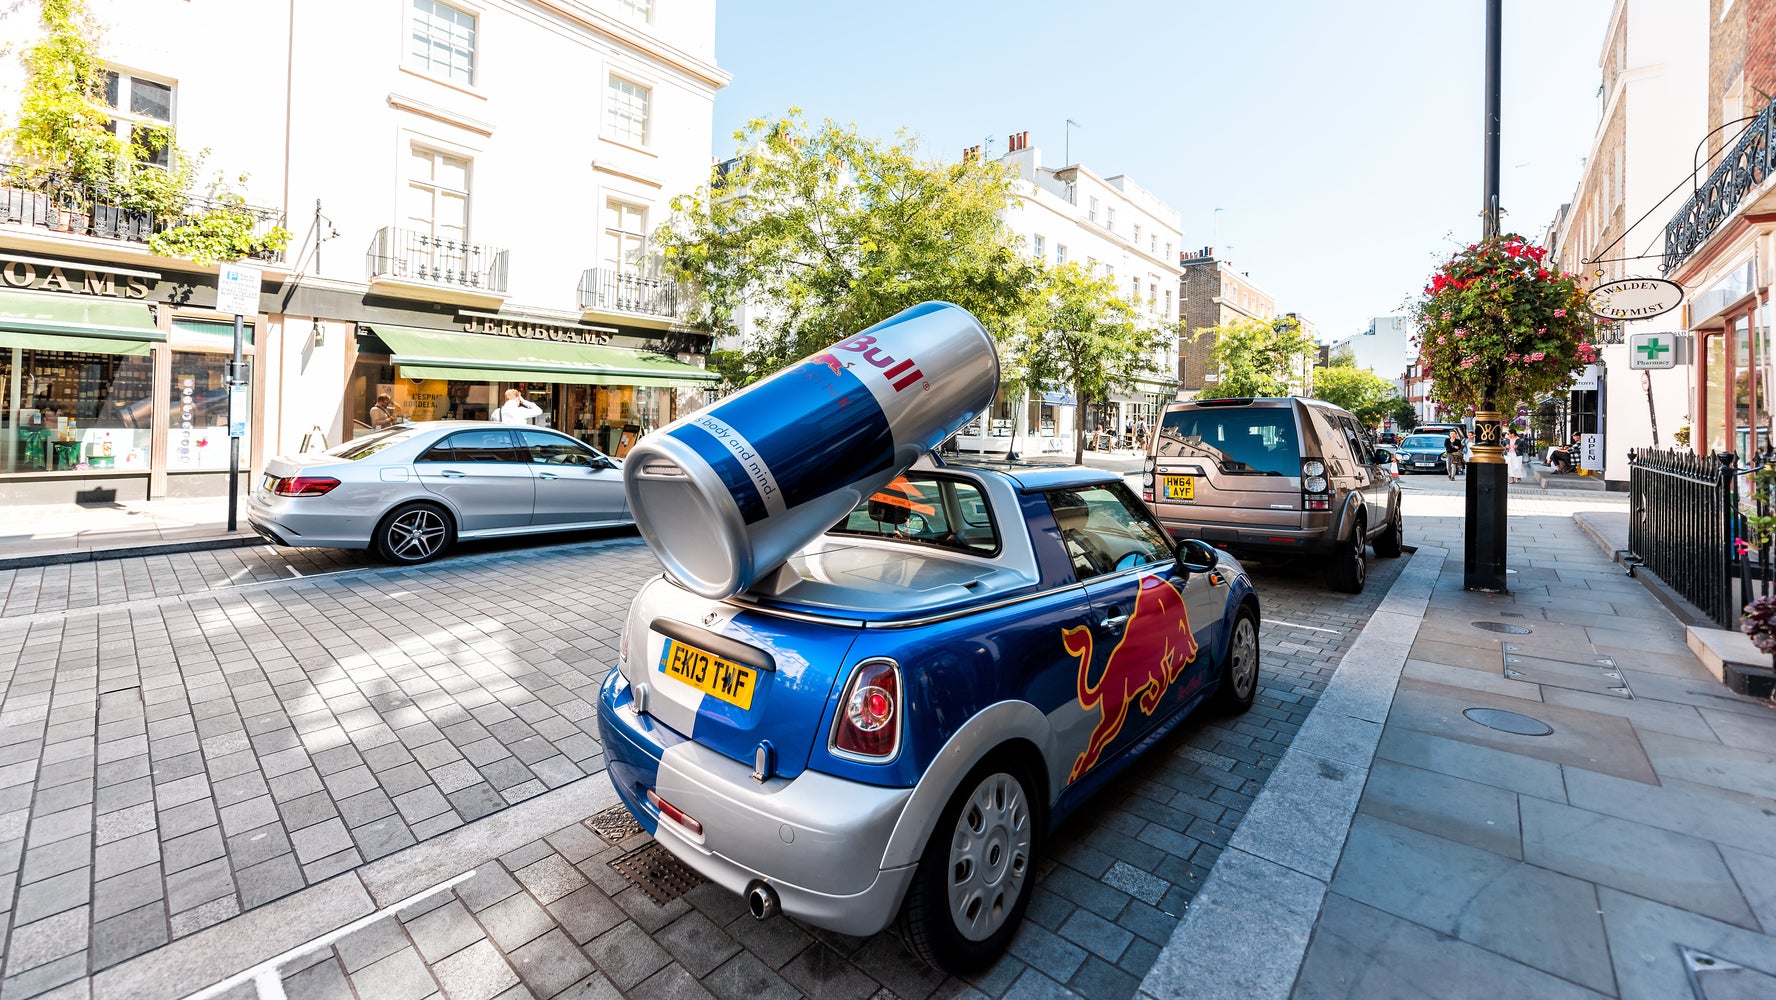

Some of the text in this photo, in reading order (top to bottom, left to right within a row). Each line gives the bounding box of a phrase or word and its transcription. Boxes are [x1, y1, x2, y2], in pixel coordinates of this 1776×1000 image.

[1603, 282, 1660, 295] WALDEN
[1601, 302, 1665, 316] CHYMIST
[465, 316, 611, 345] JEROBOAMS
[836, 335, 924, 393] Bull
[702, 418, 730, 438] body
[729, 439, 755, 461] and
[749, 462, 776, 499] mind.
[1588, 437, 1596, 461] OPEN
[1166, 477, 1192, 486] HW64
[1173, 487, 1191, 497] AYF
[671, 645, 749, 698] EK13 TWF
